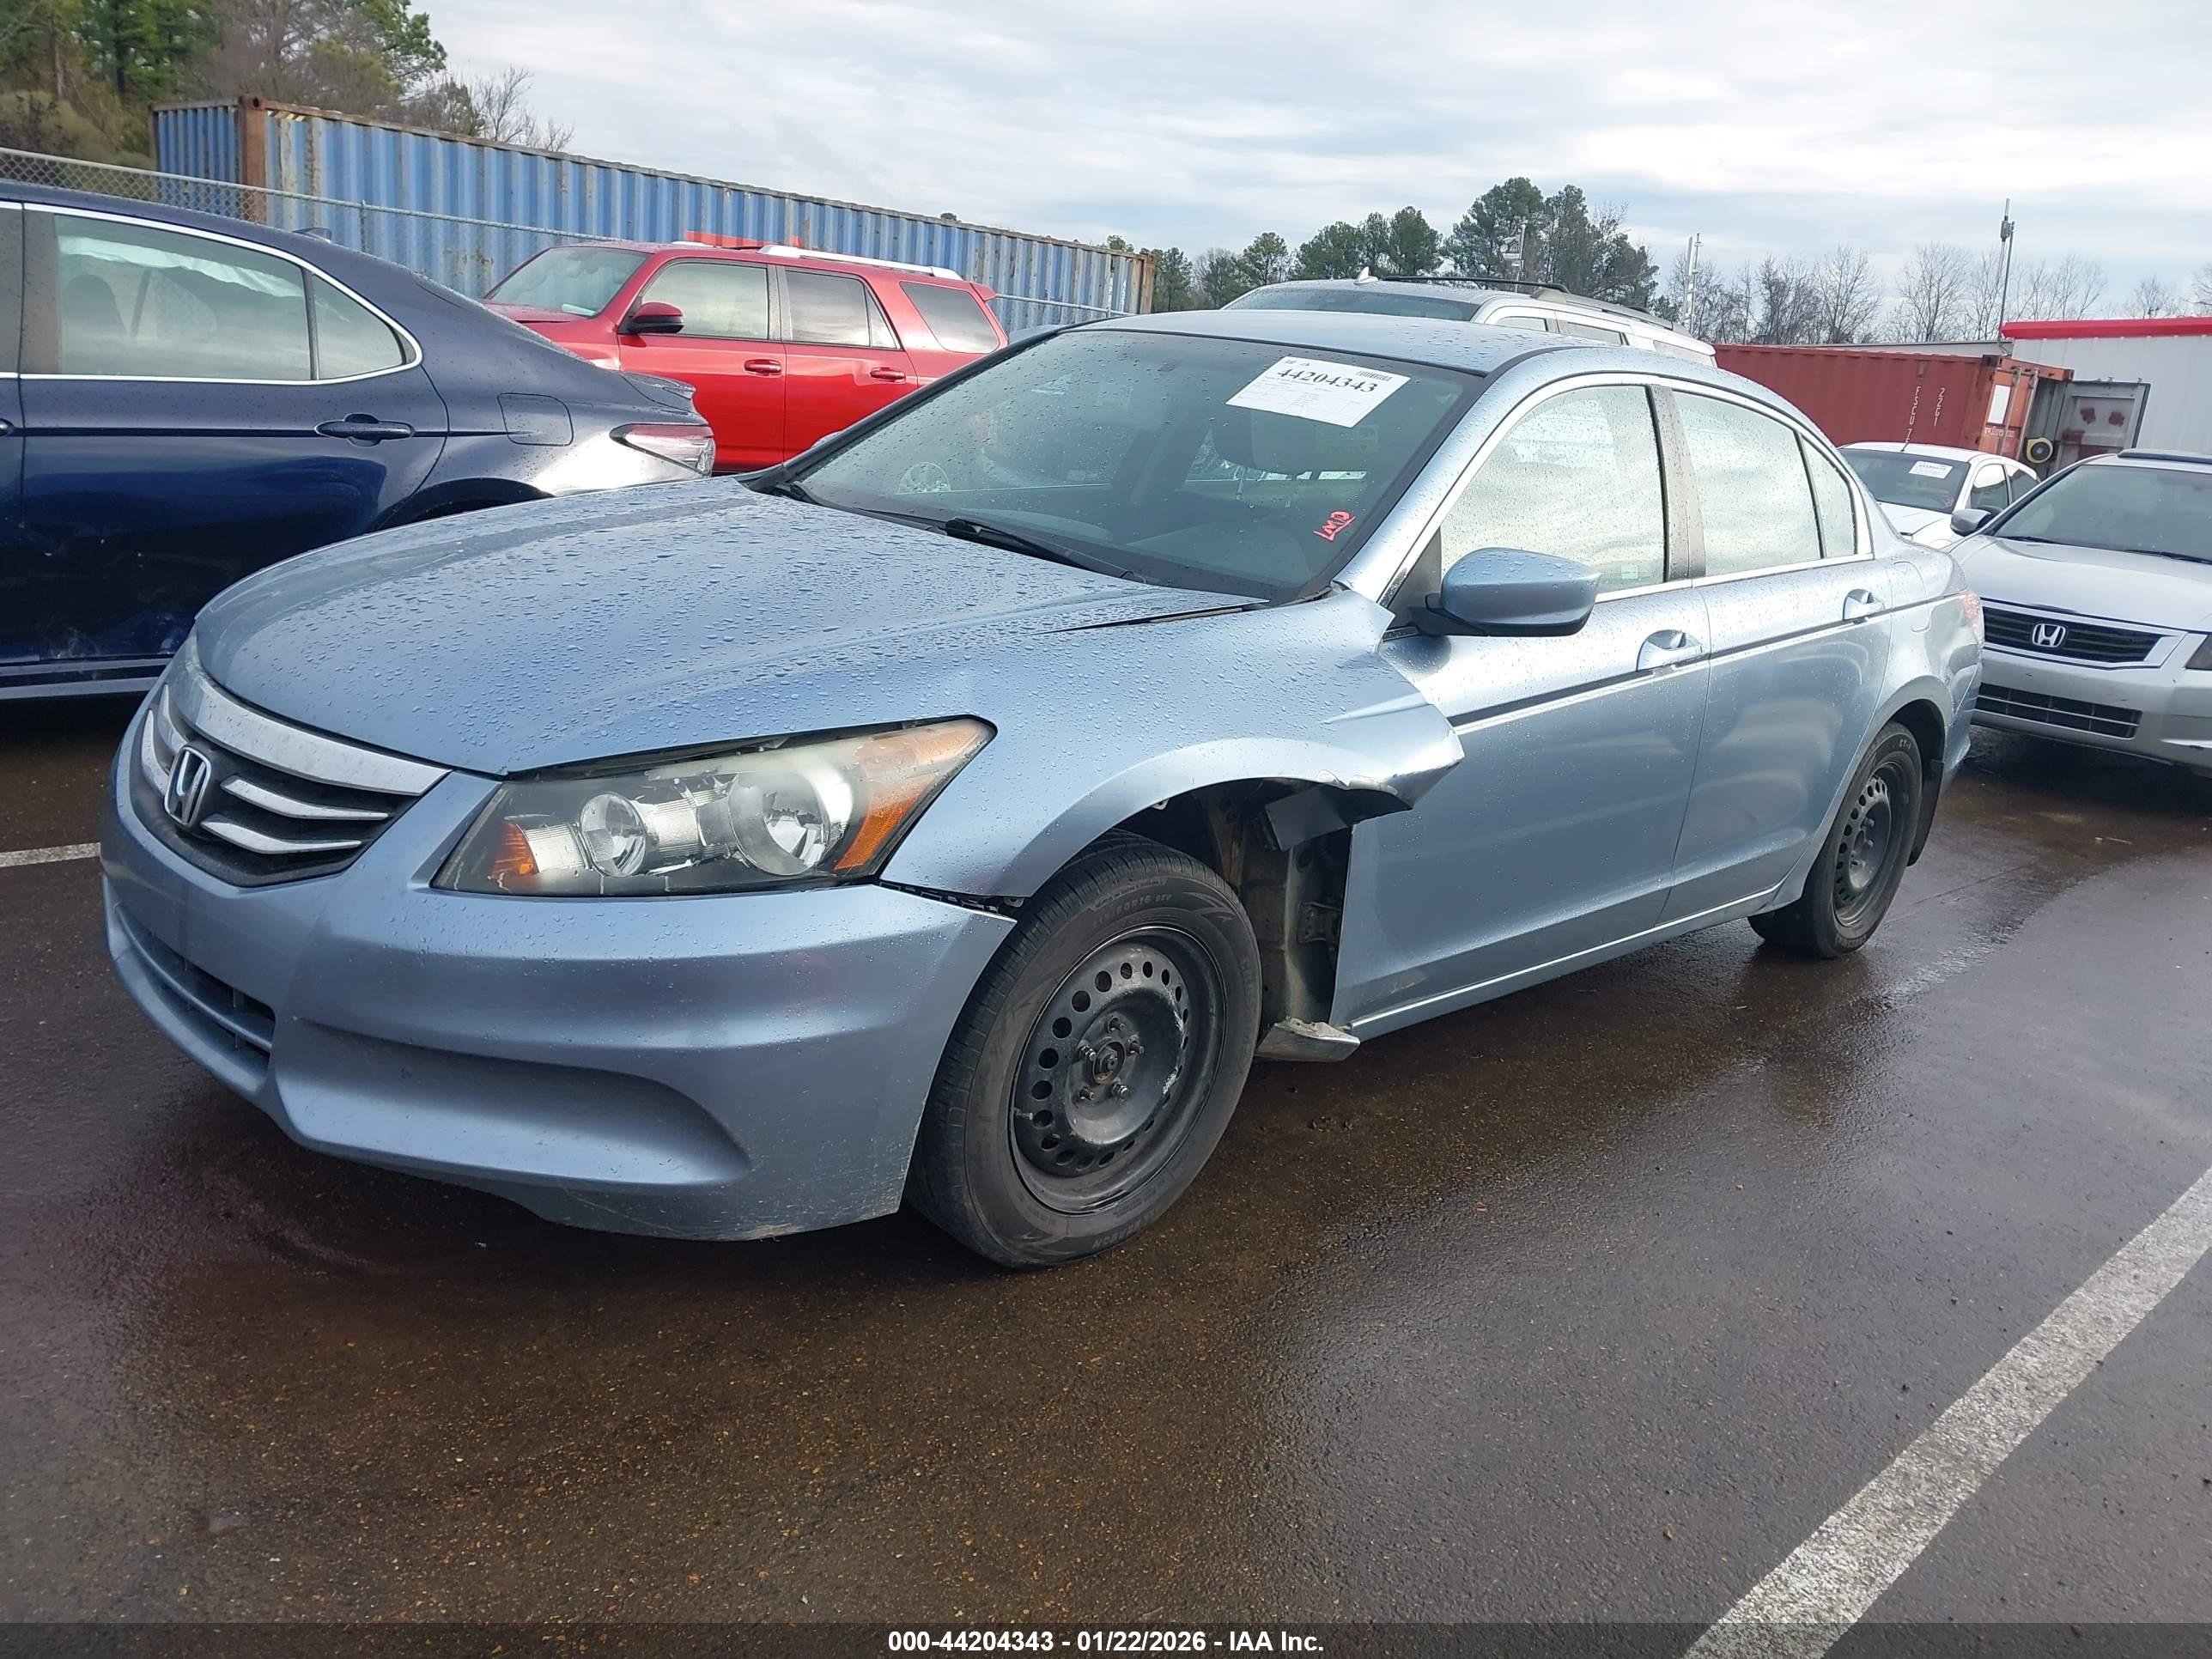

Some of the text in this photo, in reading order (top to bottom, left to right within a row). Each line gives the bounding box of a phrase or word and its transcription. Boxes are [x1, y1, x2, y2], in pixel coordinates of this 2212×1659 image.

[1277, 368, 1378, 392] 44204343
[1909, 386, 1922, 425] FSCU
[1934, 387, 1946, 426] 22G1
